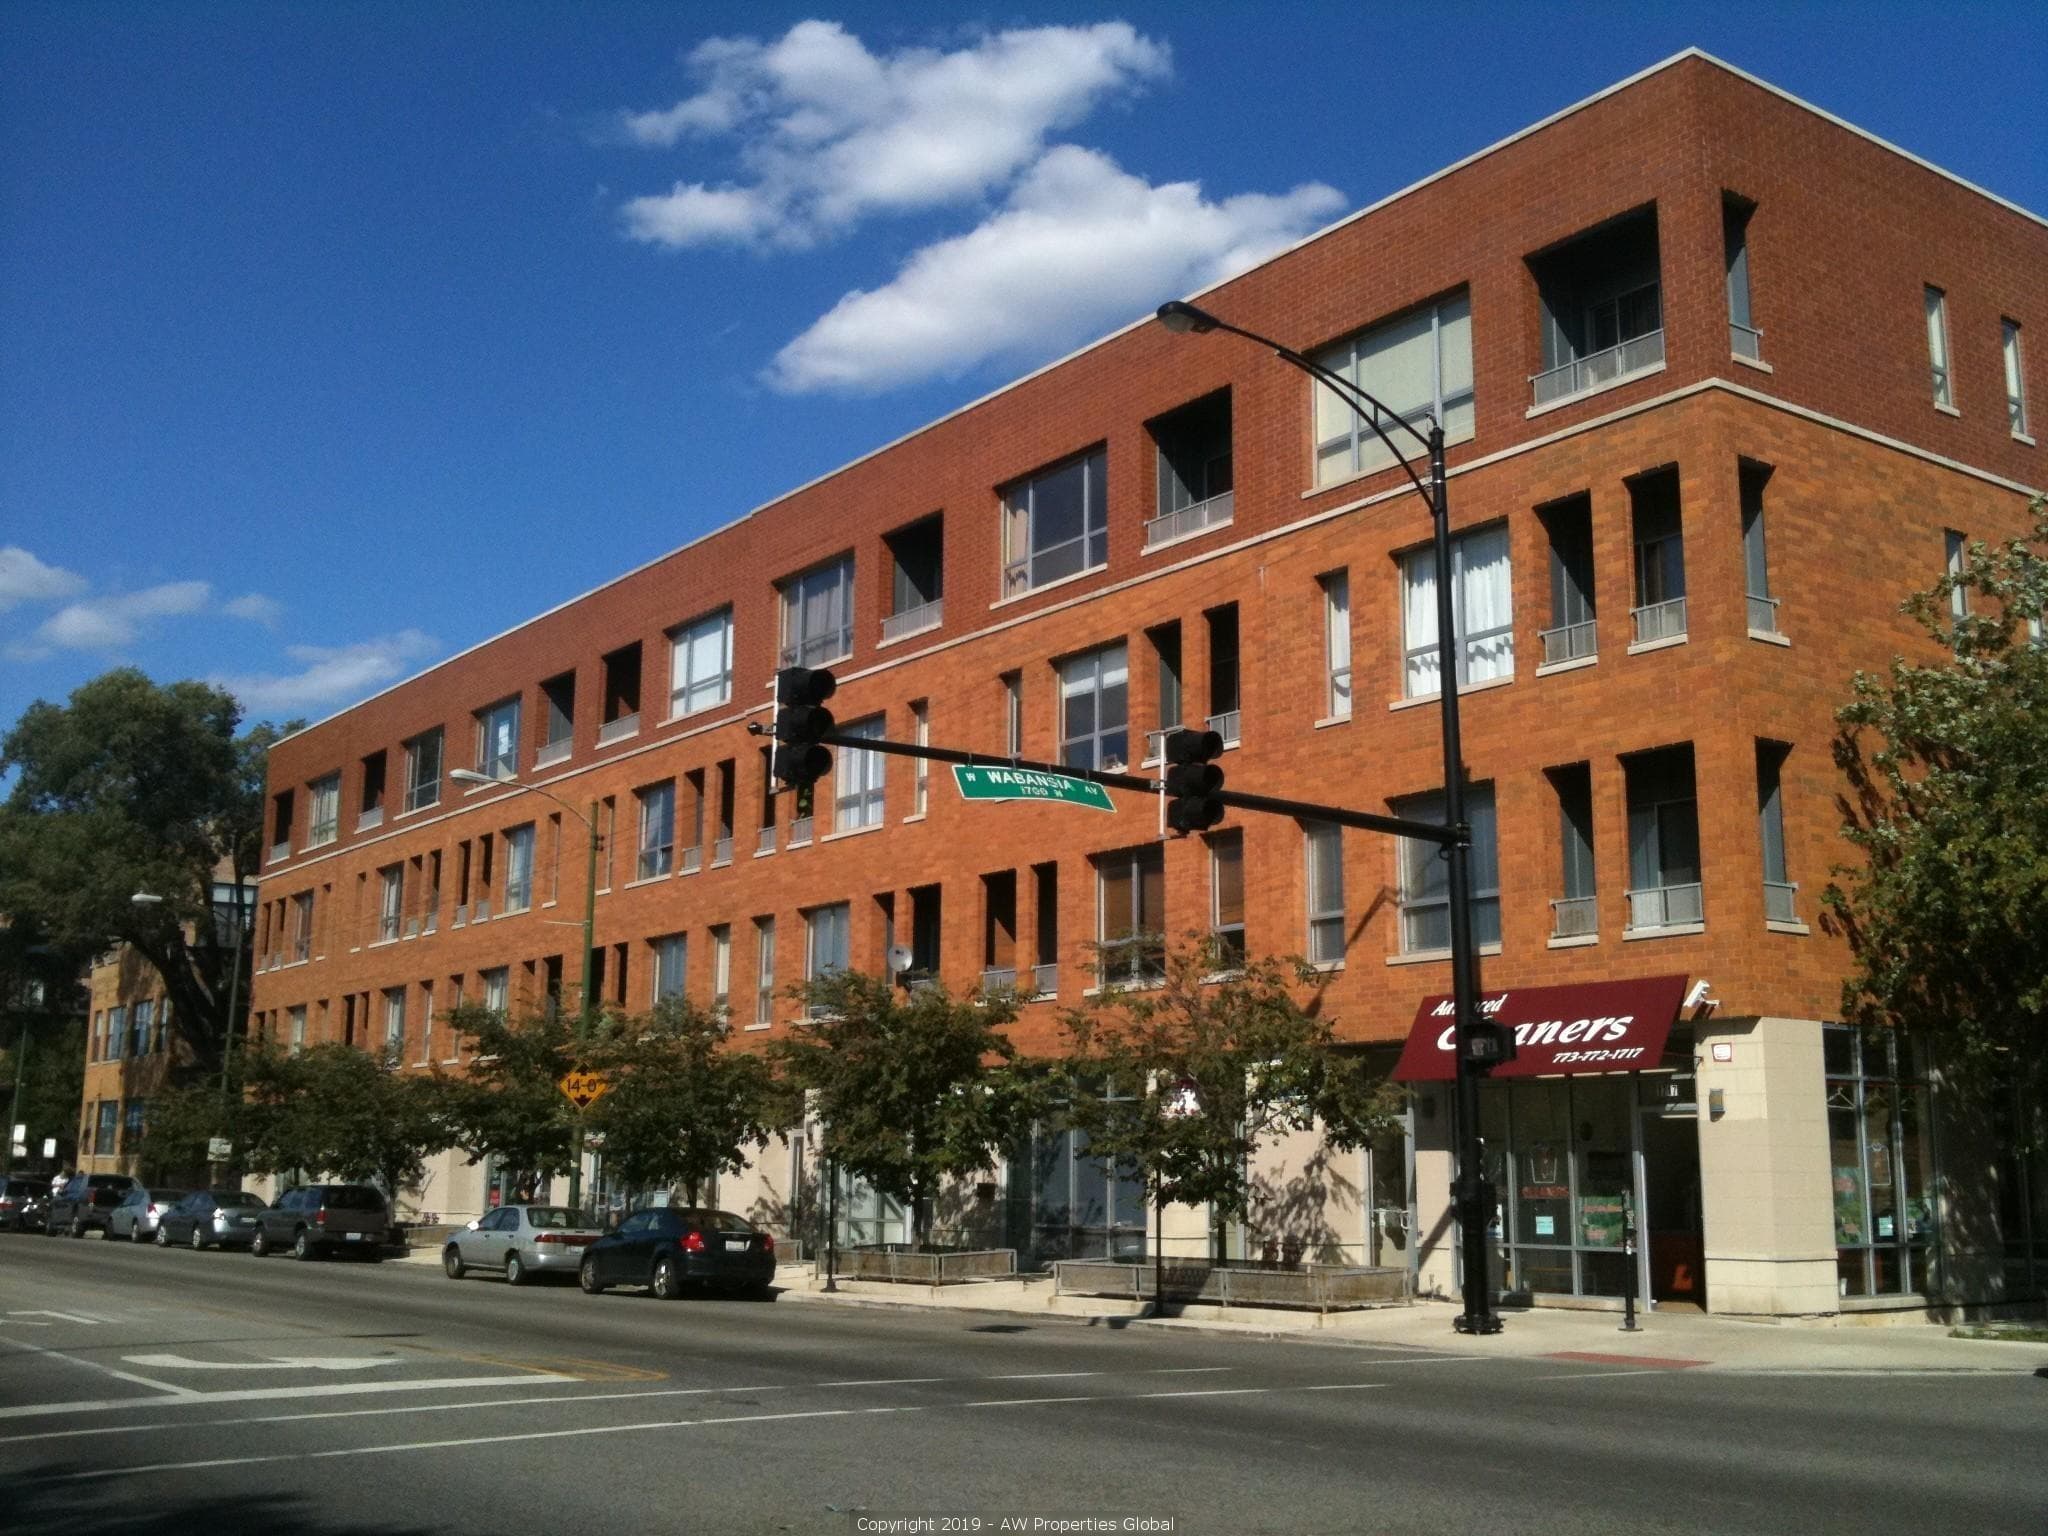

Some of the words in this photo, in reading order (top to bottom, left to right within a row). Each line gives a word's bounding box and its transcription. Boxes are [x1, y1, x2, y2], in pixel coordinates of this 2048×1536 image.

[966, 772, 975, 781] W
[987, 771, 1075, 792] WABANSIA
[1085, 785, 1099, 796] AV
[1021, 786, 1048, 796] 1700
[1437, 1015, 1634, 1050] Caners
[1552, 1047, 1645, 1064] 773-772-1717
